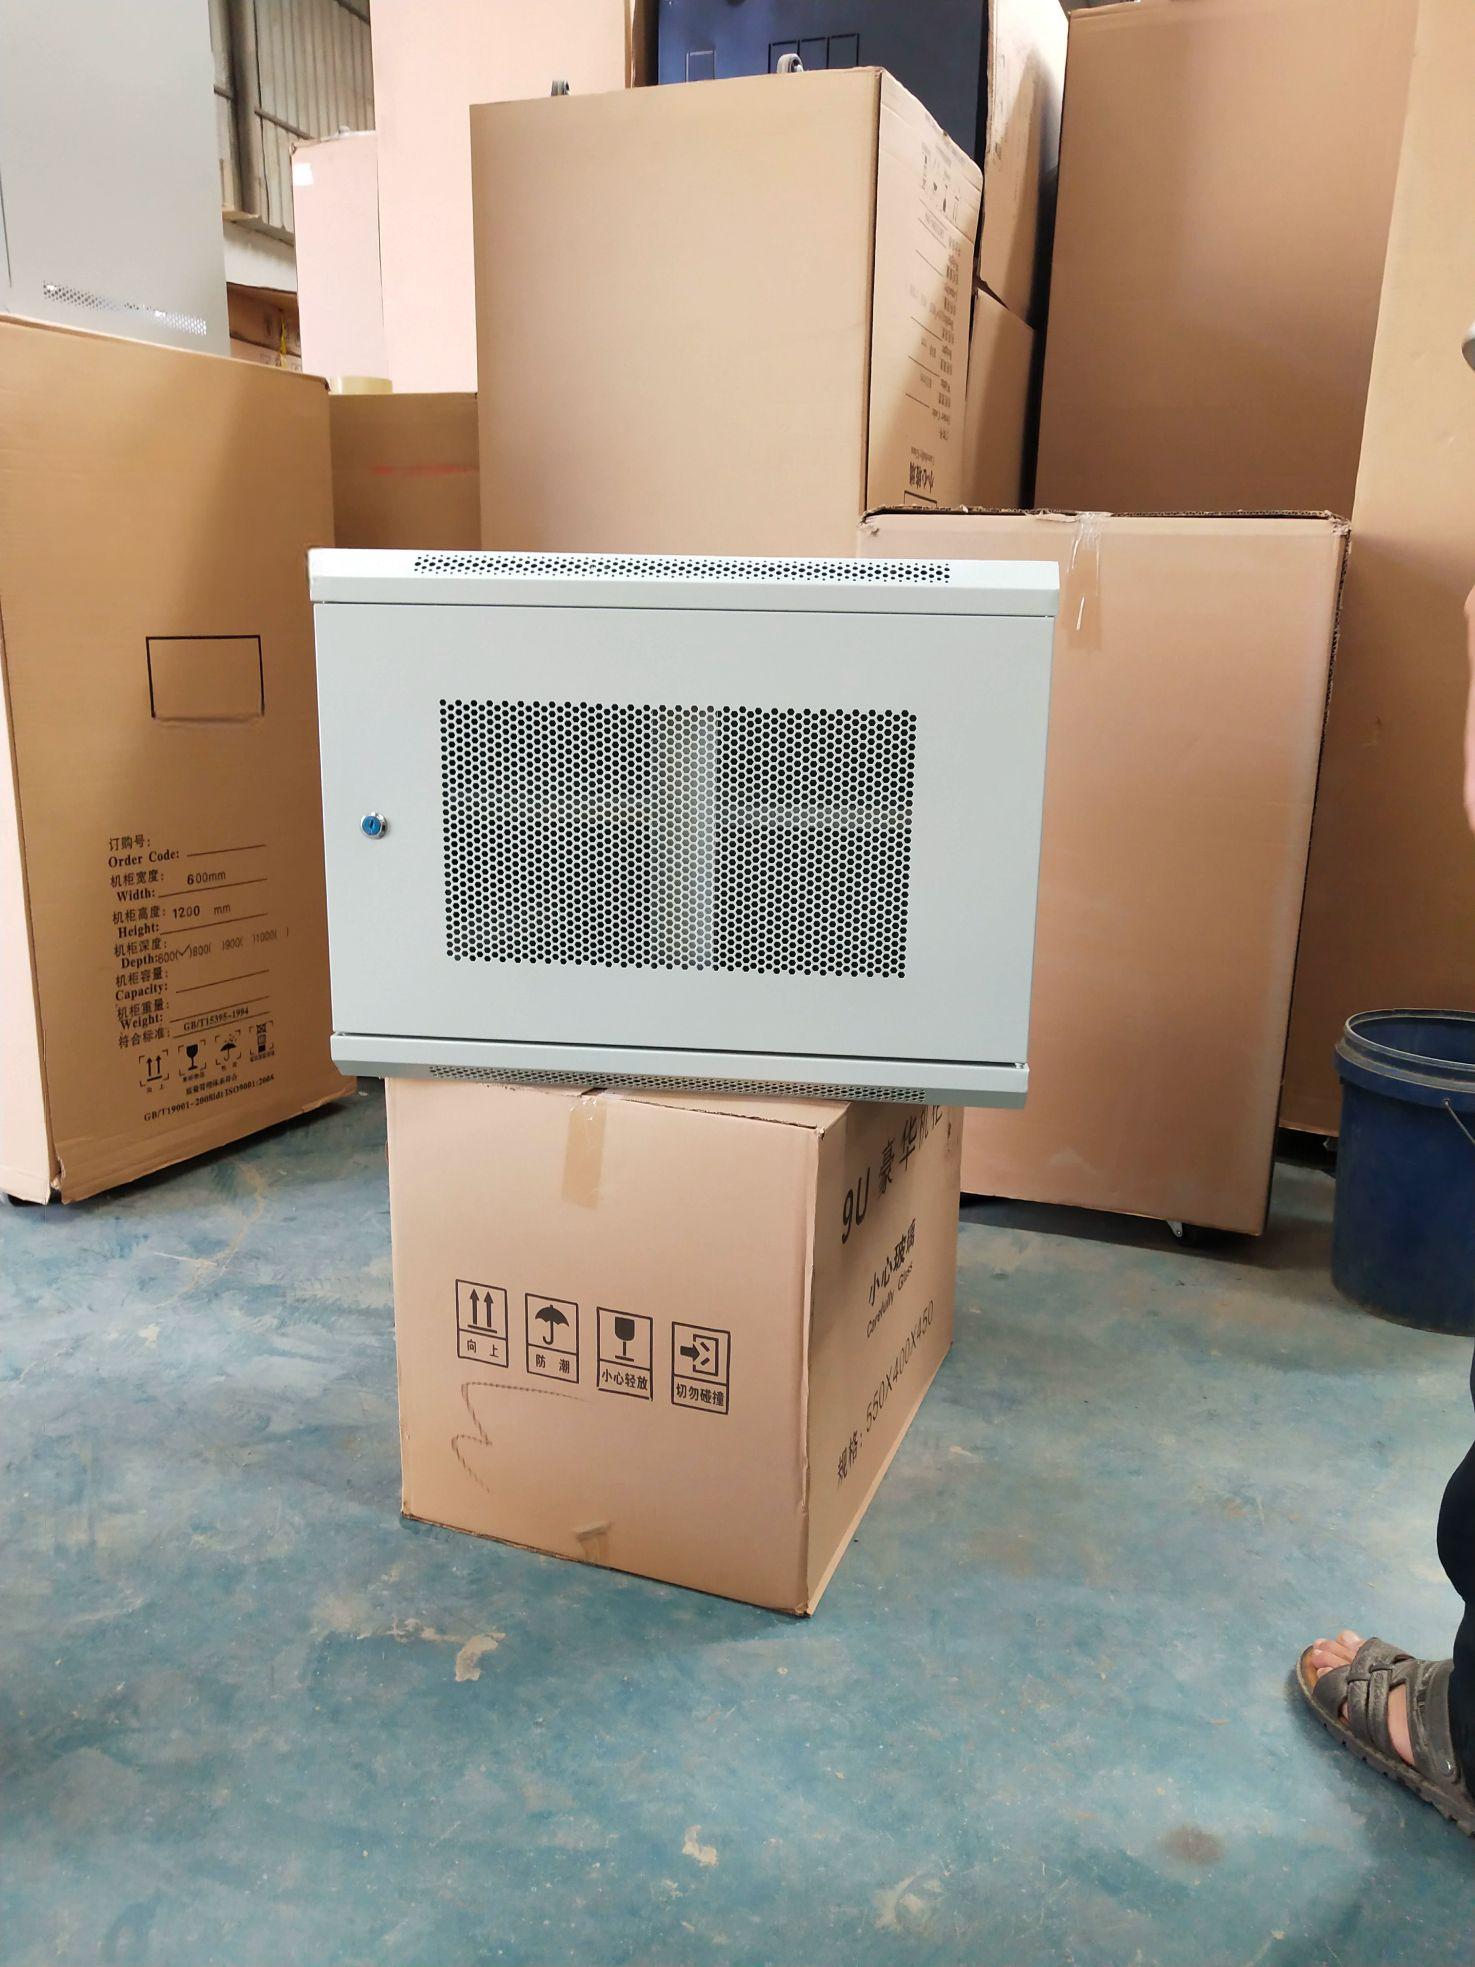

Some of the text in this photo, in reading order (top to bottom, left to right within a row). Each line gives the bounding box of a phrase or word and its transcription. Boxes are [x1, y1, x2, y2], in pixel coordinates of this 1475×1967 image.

[108, 849, 180, 868] Order Code:
[186, 870, 226, 885] 600mm
[116, 889, 156, 902] Width:
[172, 905, 200, 919] 1200
[213, 904, 231, 916] mm
[117, 923, 160, 939] Height:
[121, 954, 158, 970] Depth:
[115, 981, 168, 1001] Capacity:
[120, 1014, 163, 1030] Weight:
[841, 1167, 871, 1244] 9U
[534, 1353, 571, 1374] 防潮
[601, 1368, 649, 1391] 小心轻放
[675, 1383, 725, 1408] 切勿碰撞
